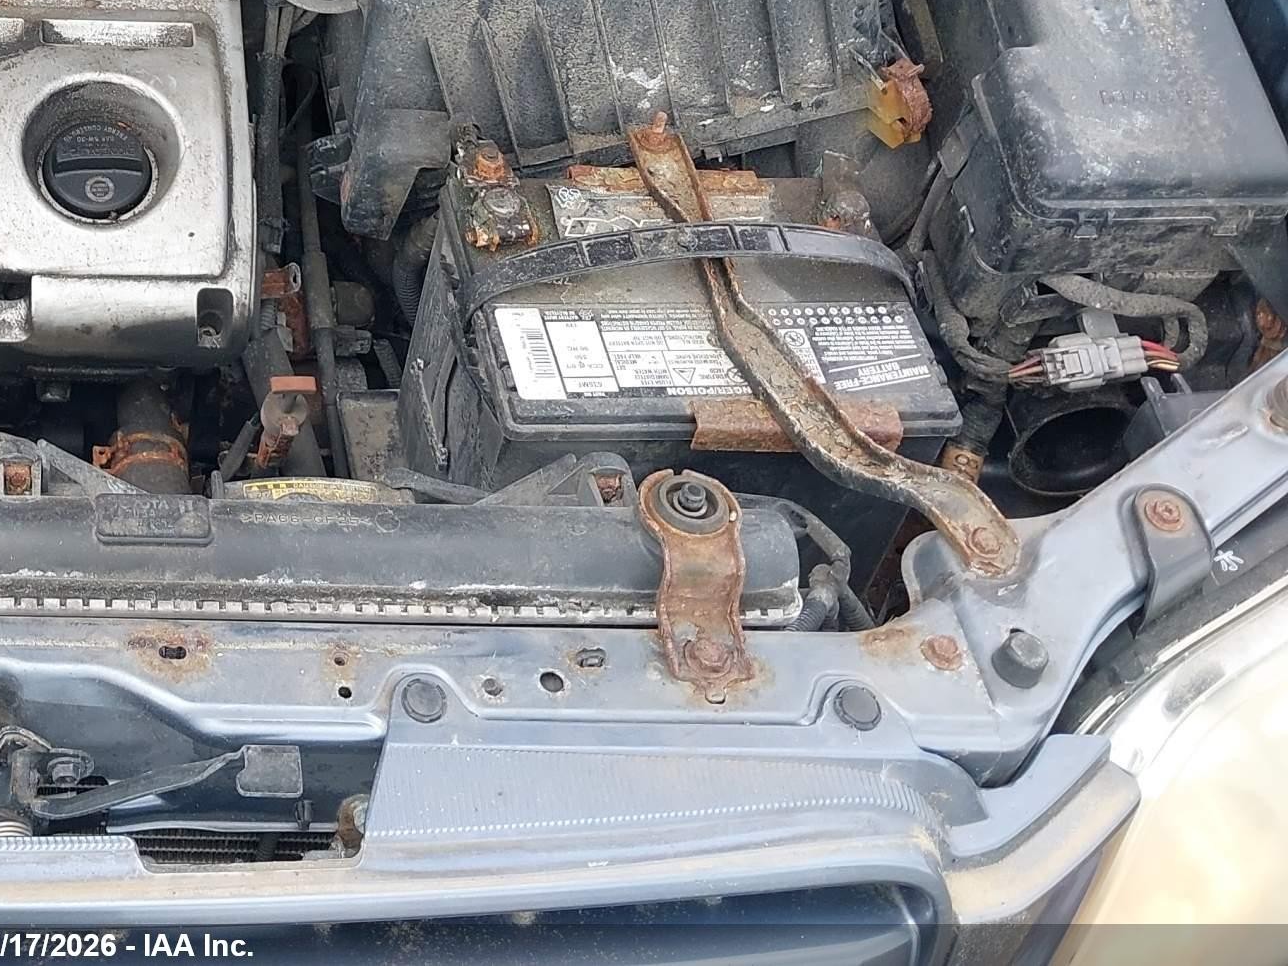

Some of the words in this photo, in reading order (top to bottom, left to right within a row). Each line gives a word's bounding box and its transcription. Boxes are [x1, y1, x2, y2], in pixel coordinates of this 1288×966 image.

[857, 362, 900, 377] BATTERY
[833, 365, 929, 391] MAINTENANCE-FREE
[666, 386, 753, 396] NGER/POISON
